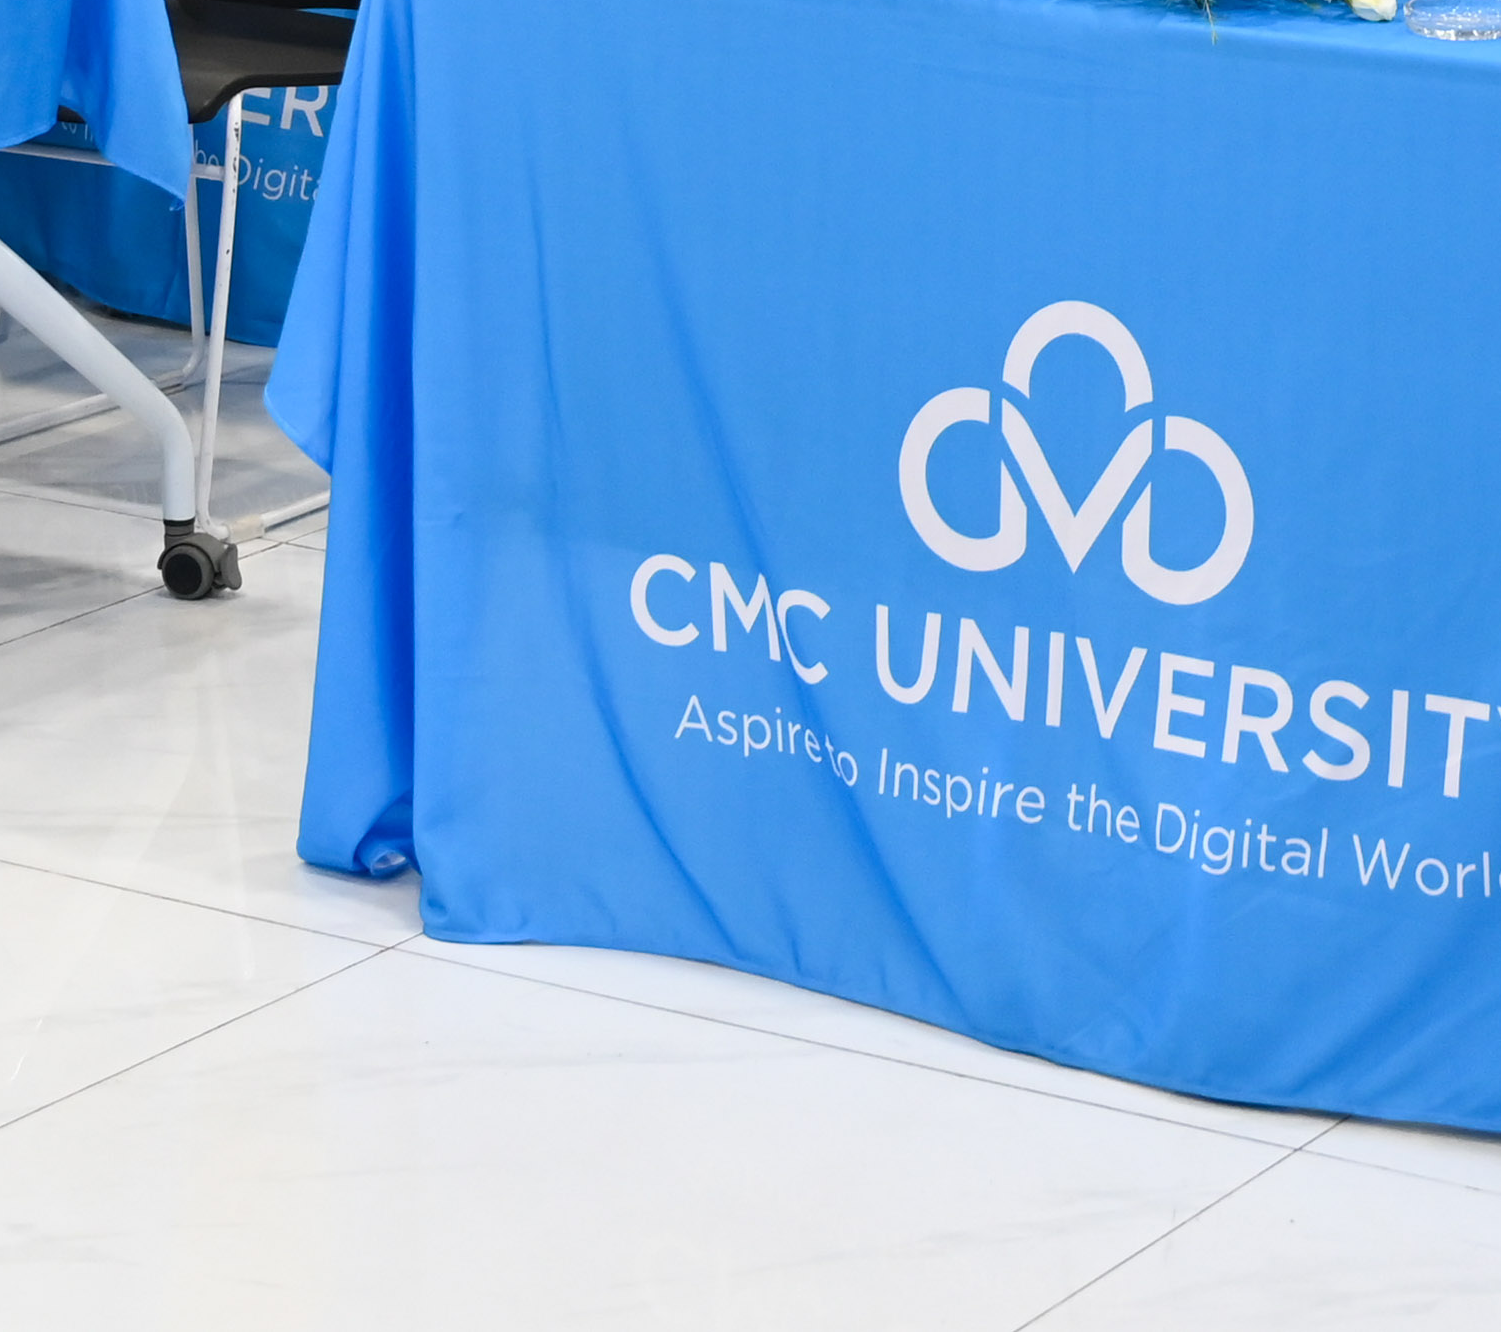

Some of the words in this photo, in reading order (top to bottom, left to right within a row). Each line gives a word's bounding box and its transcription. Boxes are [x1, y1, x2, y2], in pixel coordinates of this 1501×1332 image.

[630, 554, 831, 686] CMC
[674, 694, 821, 765] Aspire
[822, 733, 858, 787] to
[877, 746, 1046, 824] Inspire
[1066, 783, 1141, 846] the
[1154, 800, 1328, 878] Digital
